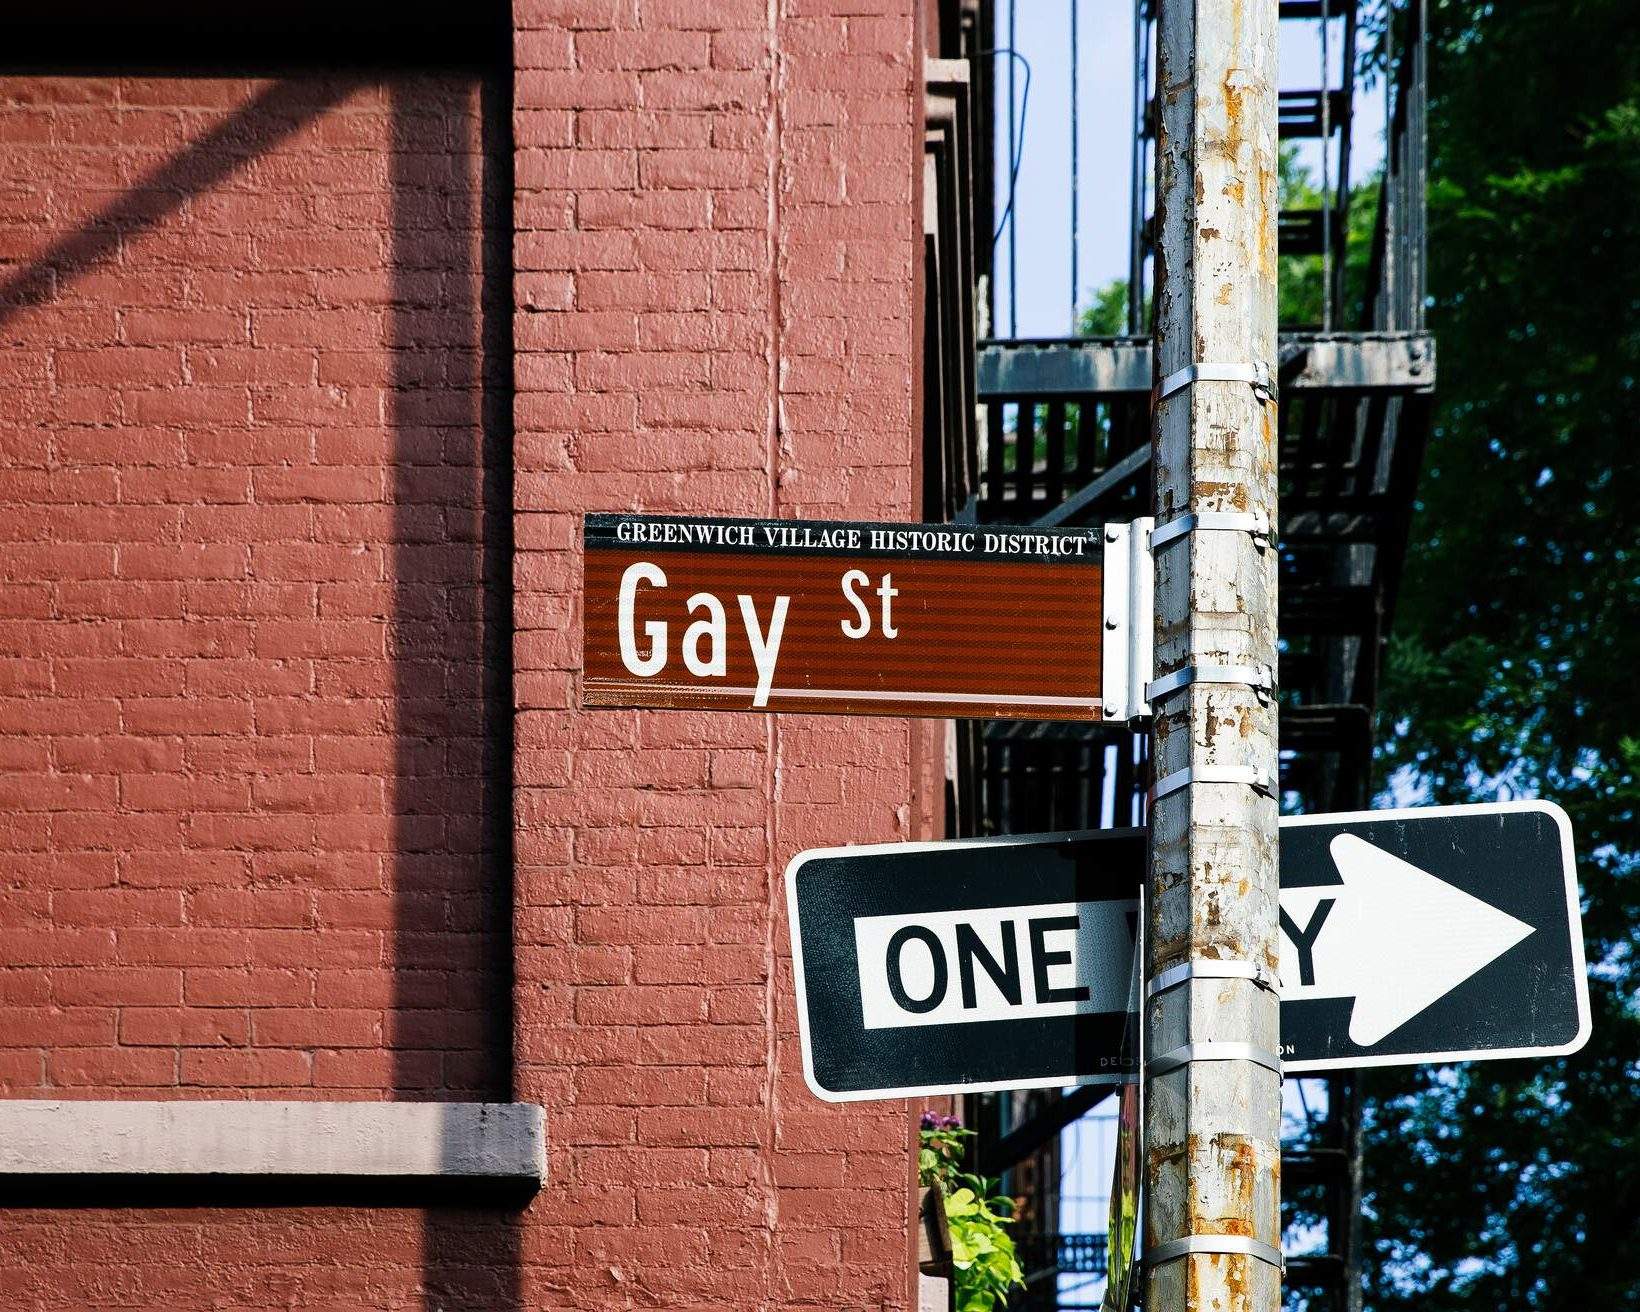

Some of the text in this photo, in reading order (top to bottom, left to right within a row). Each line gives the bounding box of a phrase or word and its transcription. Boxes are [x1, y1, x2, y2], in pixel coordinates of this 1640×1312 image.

[616, 522, 1087, 556] GREENWICH VILLAGE HISTORIC DISTRICT
[617, 561, 899, 708] Gay St
[885, 915, 1091, 1014] ONE
